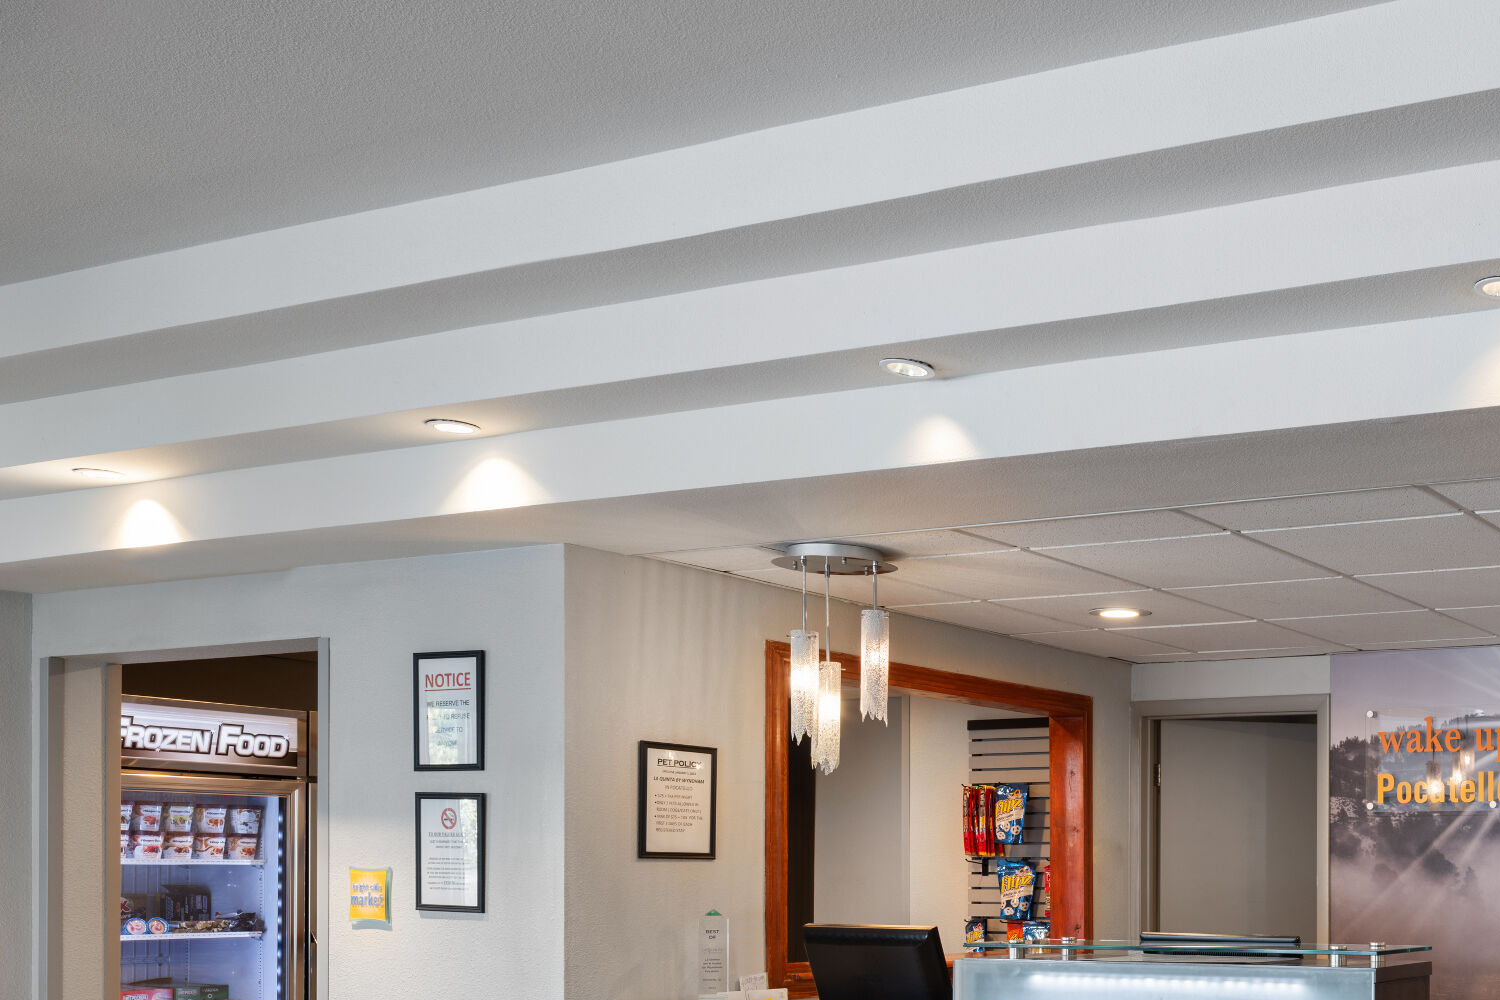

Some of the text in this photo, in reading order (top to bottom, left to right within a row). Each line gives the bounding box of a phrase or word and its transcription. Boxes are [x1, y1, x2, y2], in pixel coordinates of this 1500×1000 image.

[425, 672, 471, 688] NOTICE
[216, 723, 289, 759] FOOD
[1377, 716, 1462, 755] wake
[351, 892, 383, 906] market
